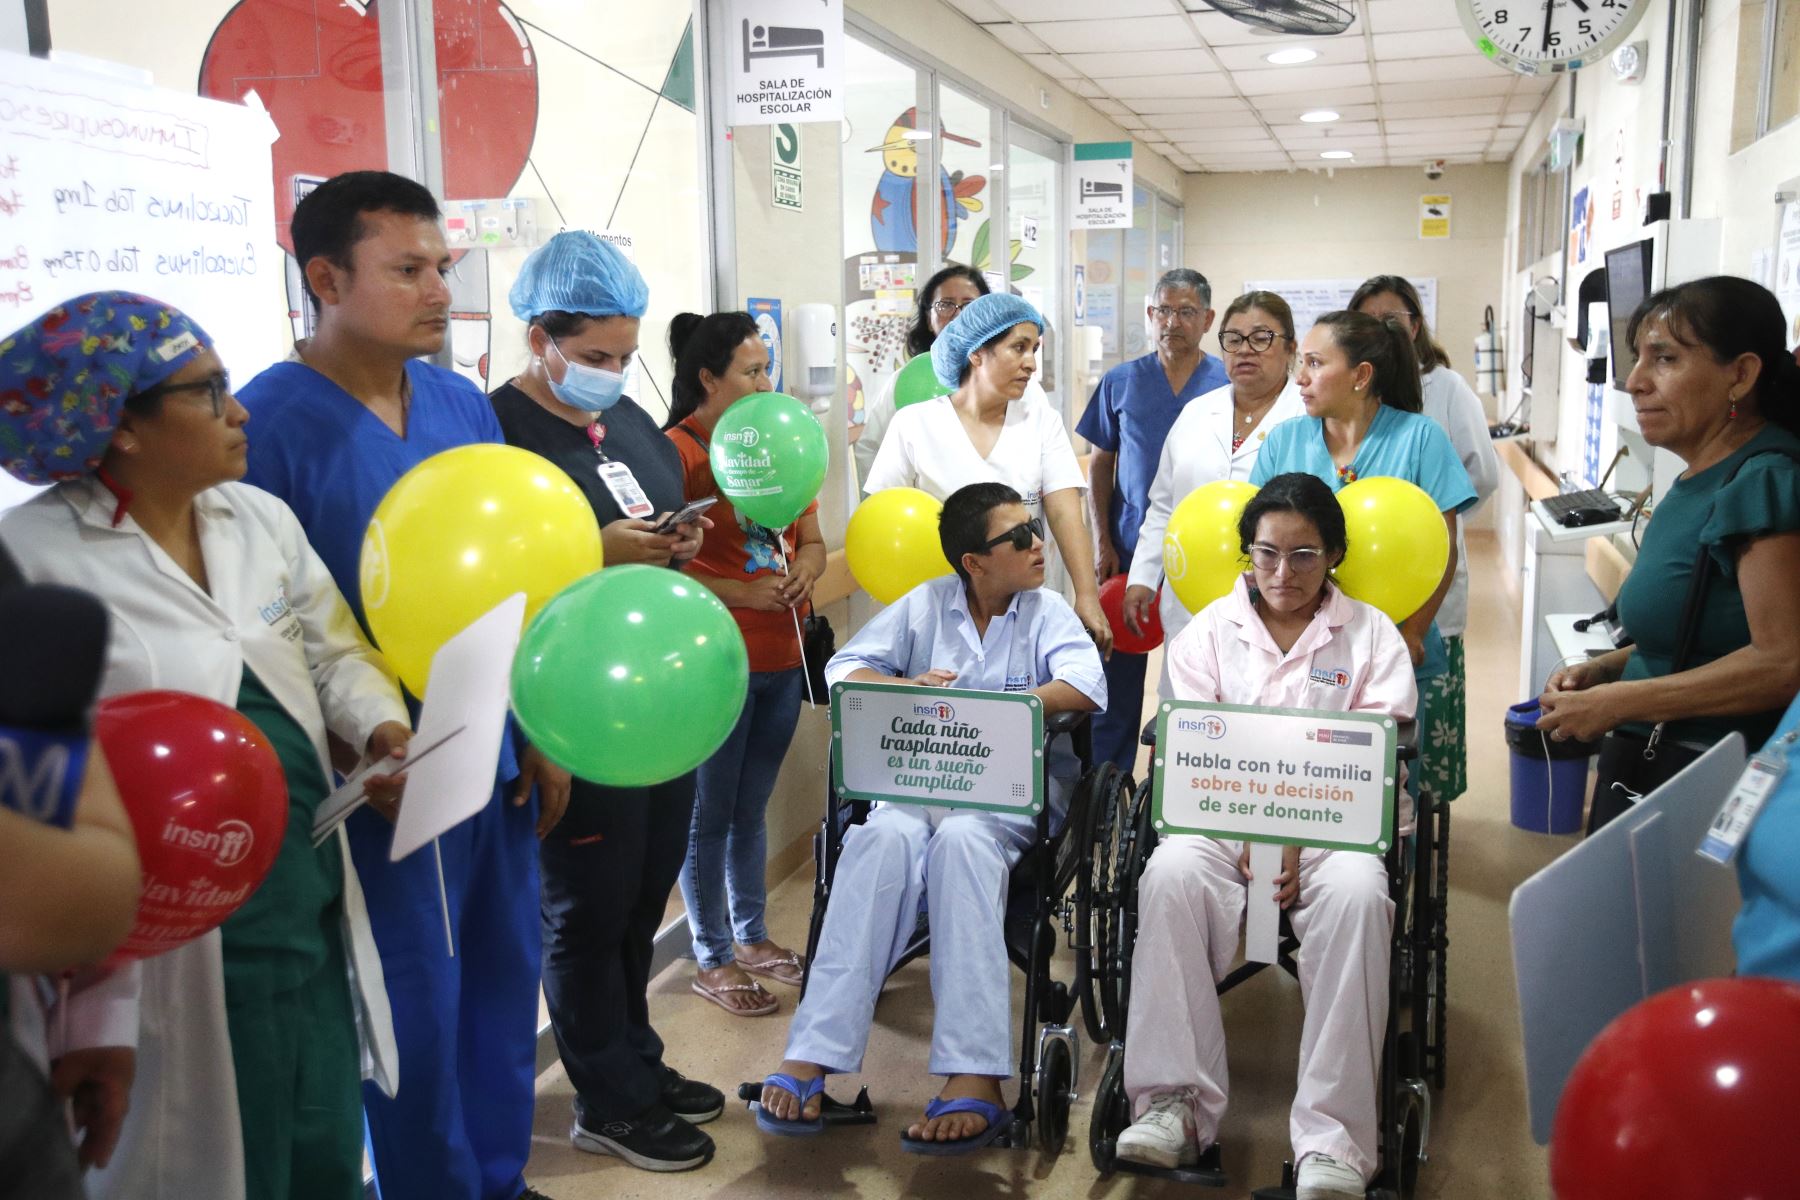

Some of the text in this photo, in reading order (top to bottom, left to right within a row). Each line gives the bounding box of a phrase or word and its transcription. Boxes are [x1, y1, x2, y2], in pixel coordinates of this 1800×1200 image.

[1494, 9, 1509, 25] 8
[1519, 26, 1532, 42] 7
[1578, 19, 1592, 35] 5
[1549, 31, 1561, 46] 6
[759, 78, 805, 90] SALA DE
[737, 88, 832, 104] HOSPITALIZACIÓN
[760, 102, 811, 114] ESCOLAR
[723, 431, 742, 441] insn
[913, 703, 938, 715] insn
[890, 716, 982, 739] Cada niño
[1178, 717, 1206, 731] insn
[880, 735, 994, 758] trasplantado
[887, 756, 987, 775] es un sueño
[1176, 751, 1372, 782] Habla con tu familia
[894, 773, 976, 793] cumplido
[1191, 775, 1354, 802] sobre tu decisión
[1199, 795, 1343, 823] de ser donante
[162, 817, 221, 850] insn
